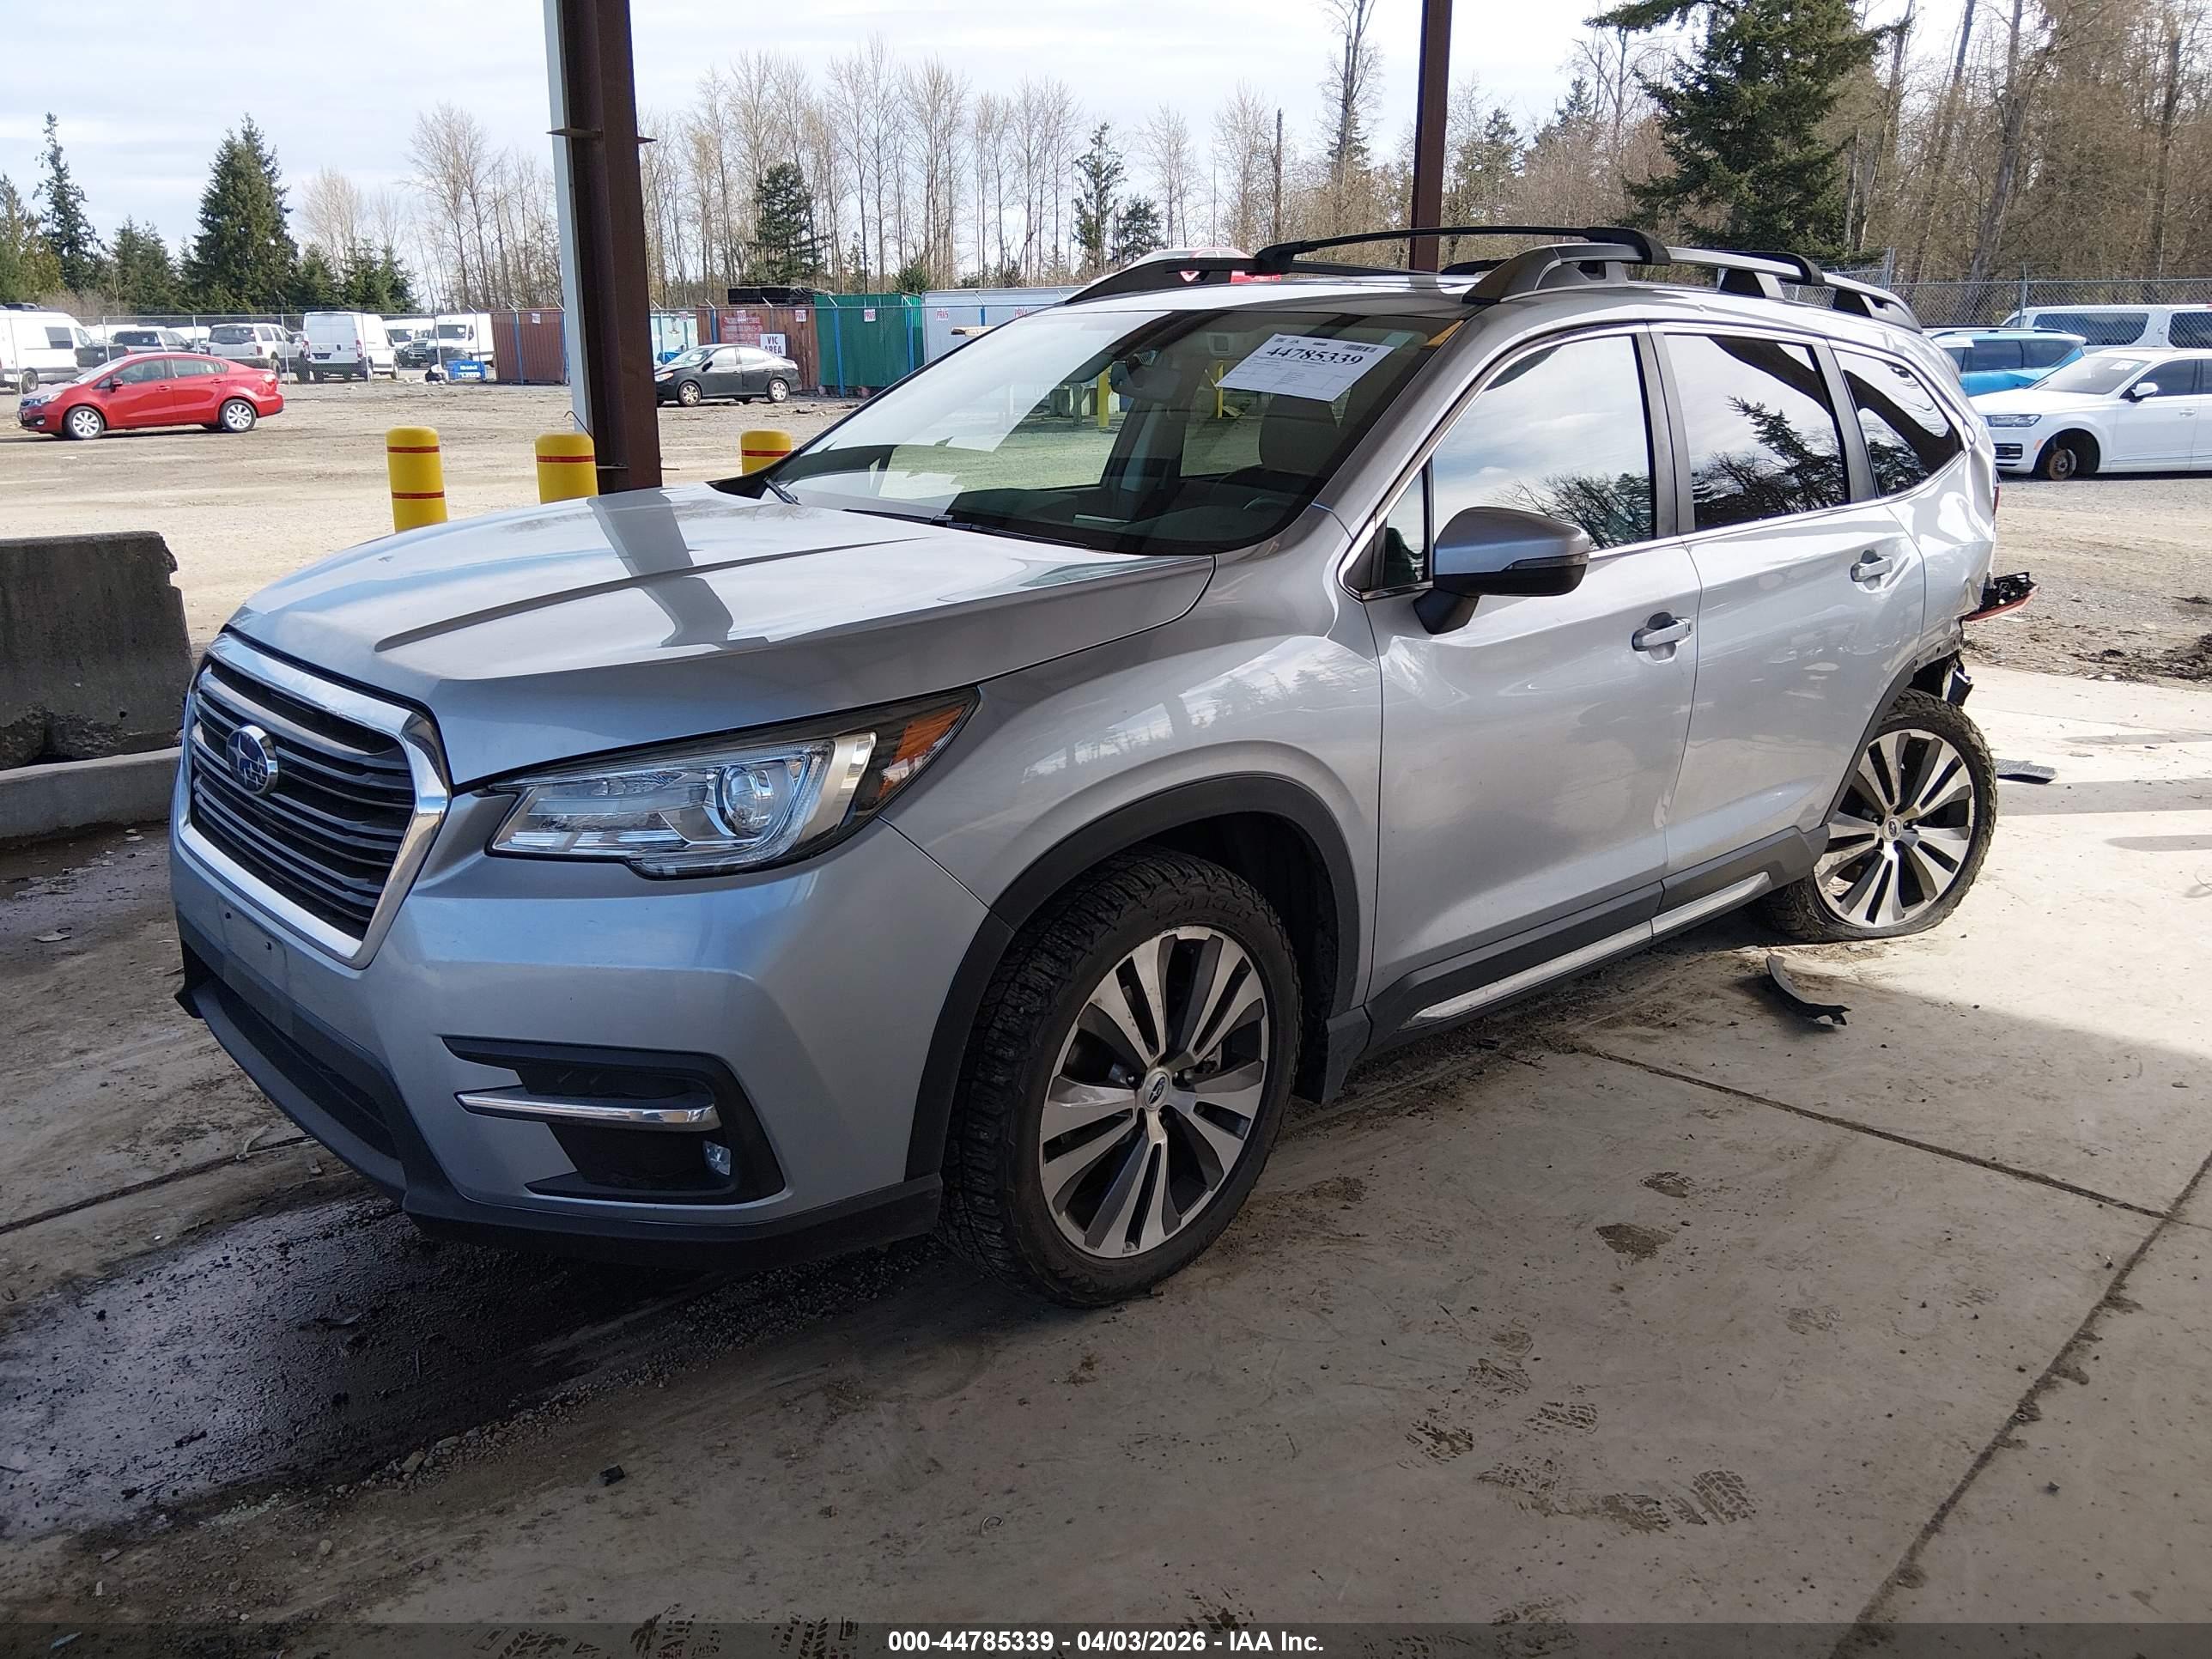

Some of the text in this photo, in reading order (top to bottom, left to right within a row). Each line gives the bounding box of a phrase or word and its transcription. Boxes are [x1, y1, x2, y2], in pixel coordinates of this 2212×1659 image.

[767, 336, 779, 345] VIC
[764, 345, 782, 355] AREA
[1267, 346, 1364, 366] 44785339
